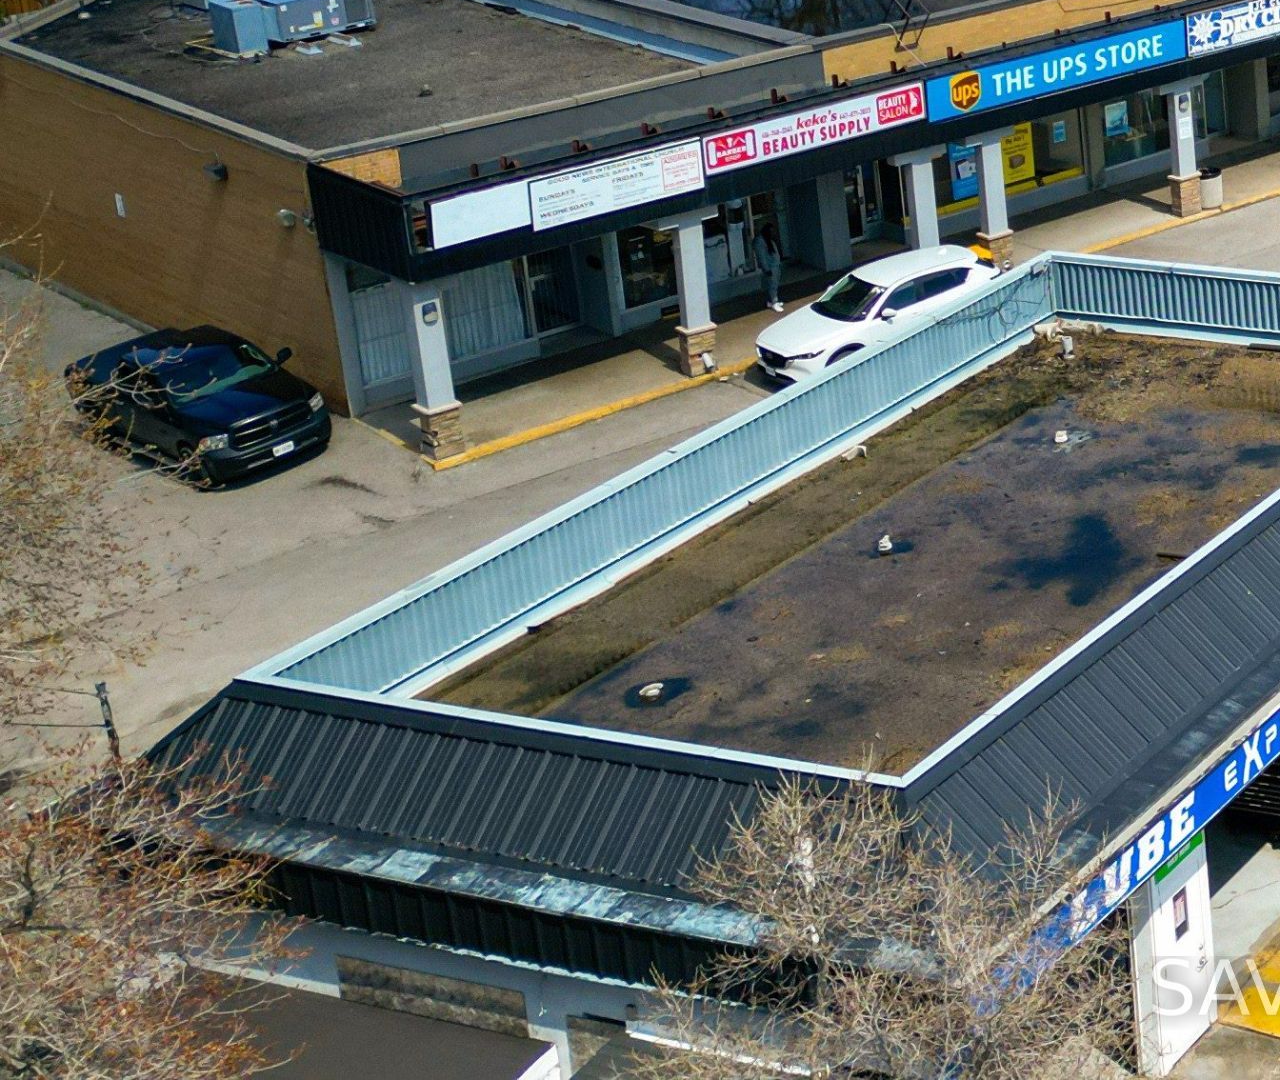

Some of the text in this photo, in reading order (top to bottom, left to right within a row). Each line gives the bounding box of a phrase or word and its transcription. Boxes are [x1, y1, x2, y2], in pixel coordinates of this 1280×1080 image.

[1221, 13, 1256, 39] DRY
[952, 82, 980, 106] ups
[992, 65, 1035, 96] THE
[1043, 53, 1087, 83] UPS
[1095, 34, 1163, 71] STORE
[878, 95, 907, 110] BEAUTY
[796, 110, 837, 131] keke's
[879, 105, 909, 120] SALON
[762, 128, 815, 156] BEAUTY
[820, 116, 871, 142] SUPPLY
[611, 171, 644, 184] FRIDAYS
[538, 188, 576, 203] SUNDAYS
[540, 200, 594, 219] WEDNESDAYS
